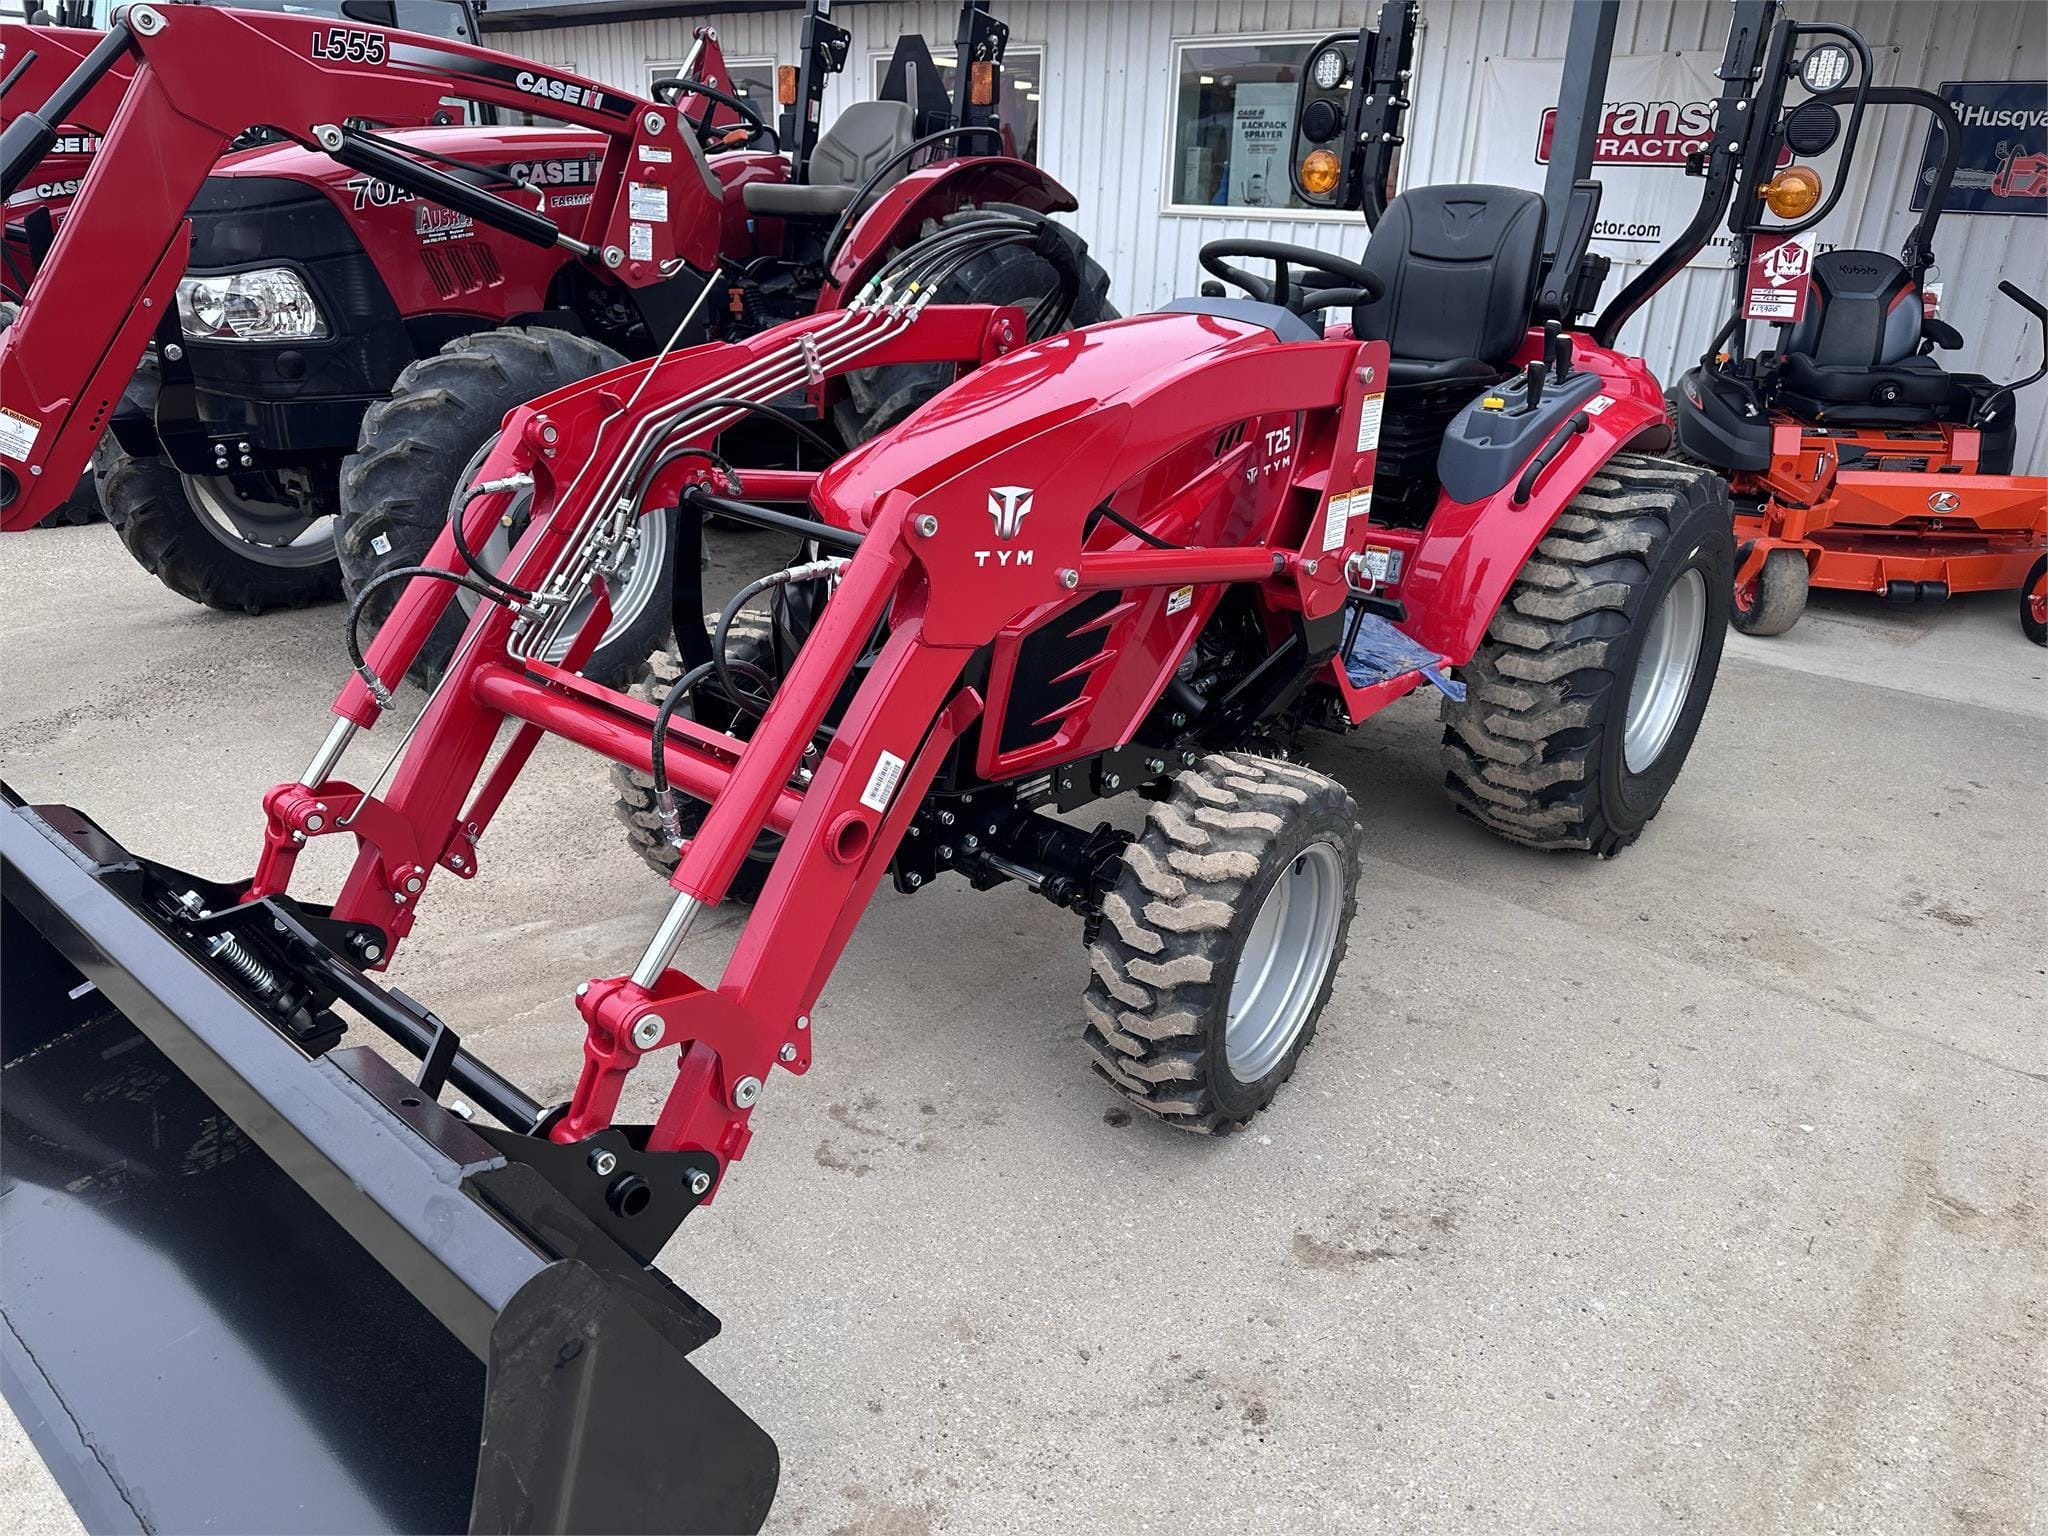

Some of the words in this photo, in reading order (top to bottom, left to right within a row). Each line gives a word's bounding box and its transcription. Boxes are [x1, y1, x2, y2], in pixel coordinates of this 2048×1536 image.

[311, 28, 385, 65] L555
[516, 71, 581, 105] CASE
[1241, 121, 1288, 130] BACKPACK
[1597, 100, 1720, 137] rans
[1243, 130, 1284, 140] SPRAYER
[51, 137, 80, 153] SE
[1596, 139, 1702, 157] RACTO
[510, 161, 580, 184] CASE
[551, 193, 593, 208] FARMA
[1594, 219, 1661, 237] ctor.com
[1839, 264, 1878, 276] Kubota
[1265, 426, 1291, 457] T25
[1263, 455, 1291, 477] TYM
[974, 549, 1034, 567] TYM
